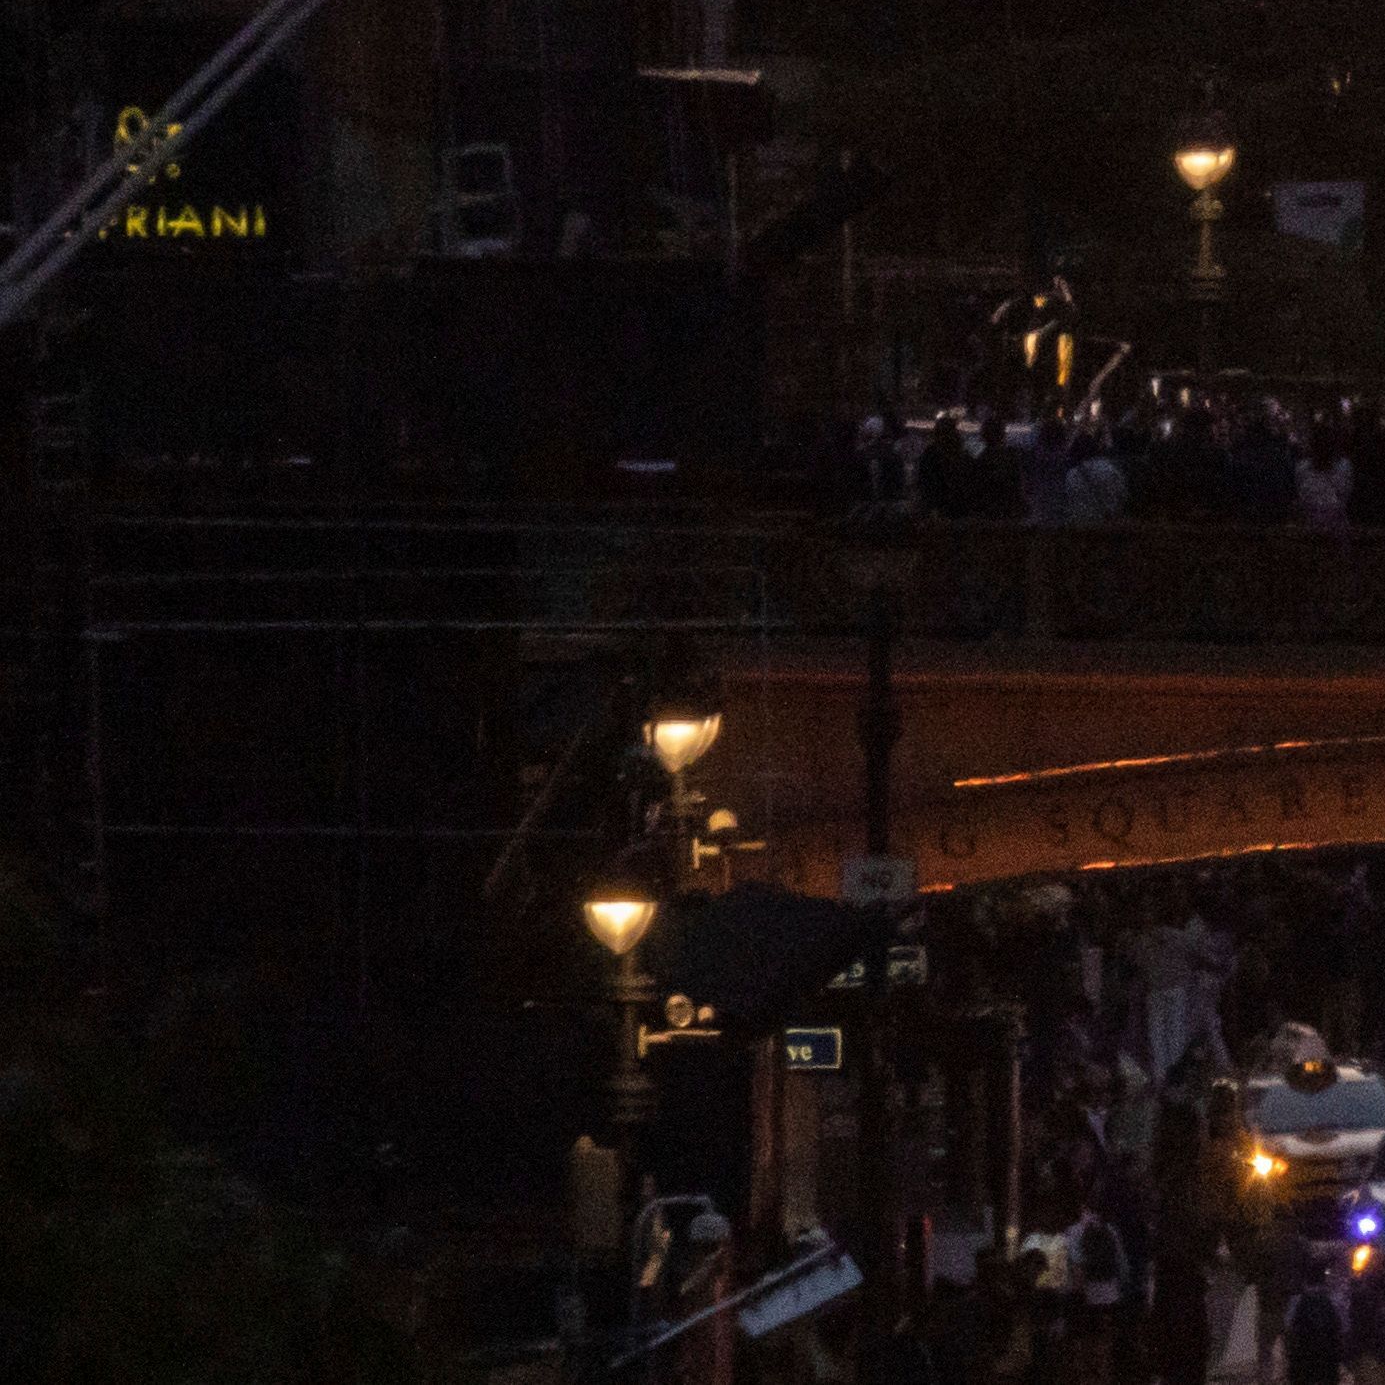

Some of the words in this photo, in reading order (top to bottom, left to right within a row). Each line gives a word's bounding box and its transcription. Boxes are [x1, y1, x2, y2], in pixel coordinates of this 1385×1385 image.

[100, 204, 269, 240] RIANI
[1044, 776, 1366, 848] SQUARE
[786, 1044, 814, 1061] ve
